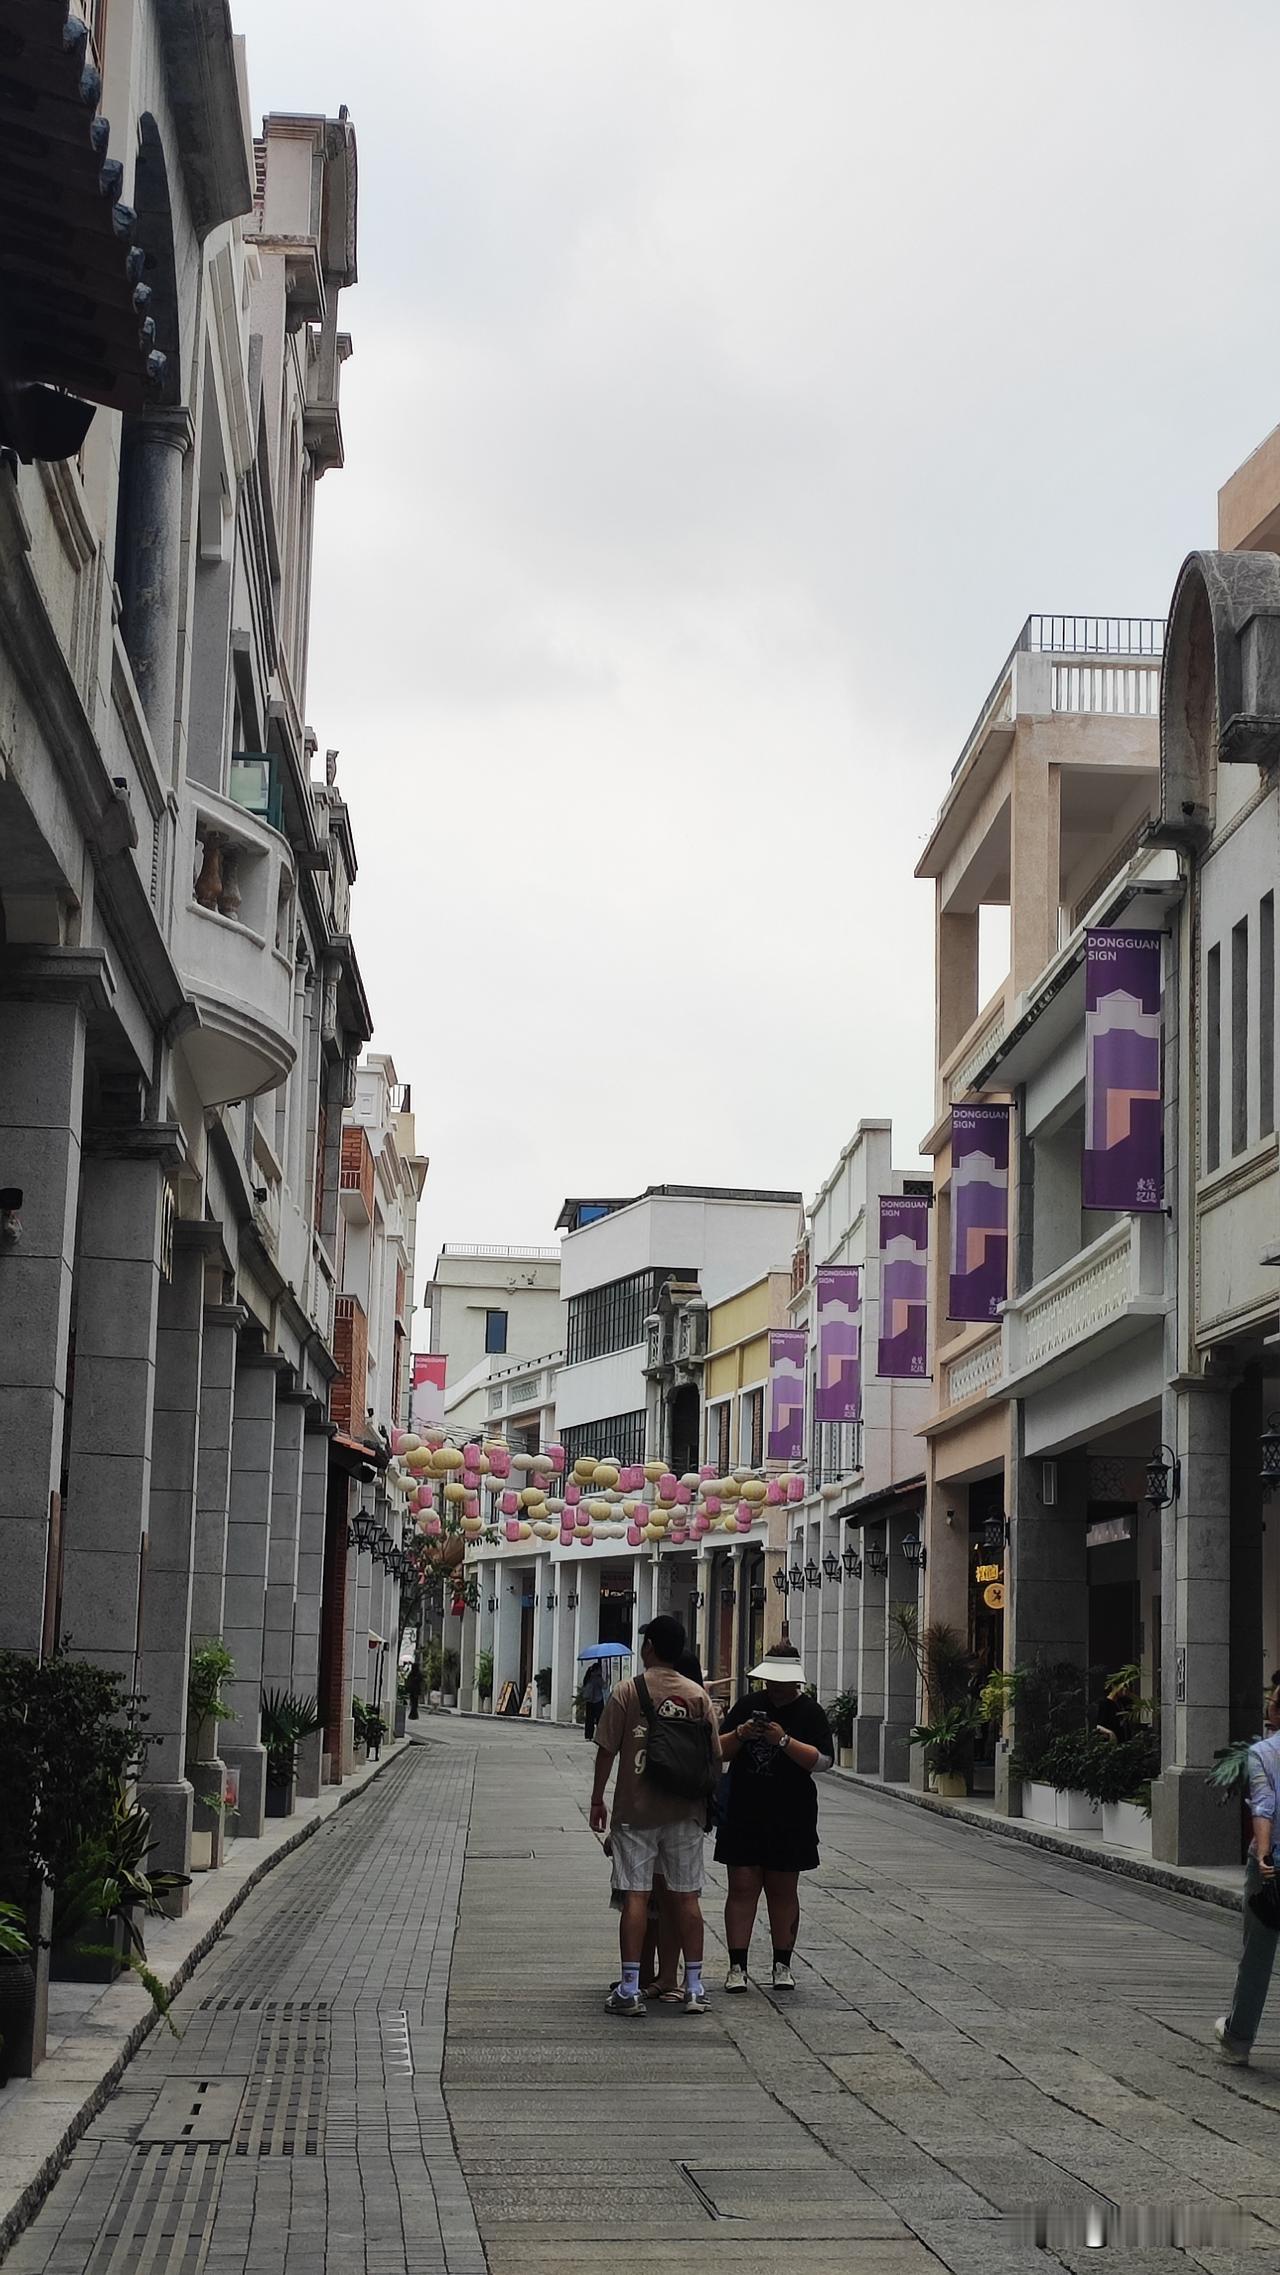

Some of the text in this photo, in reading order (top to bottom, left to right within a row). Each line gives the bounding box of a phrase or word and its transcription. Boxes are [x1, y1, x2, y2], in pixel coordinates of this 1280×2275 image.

[1087, 937, 1159, 949] DONGGUAN
[1088, 951, 1117, 961] SIGN
[953, 1110, 1009, 1120] DONGGUAN
[953, 1120, 976, 1129] SIGN
[881, 1201, 928, 1209] DONGGUAN
[881, 1209, 900, 1217] SIGN
